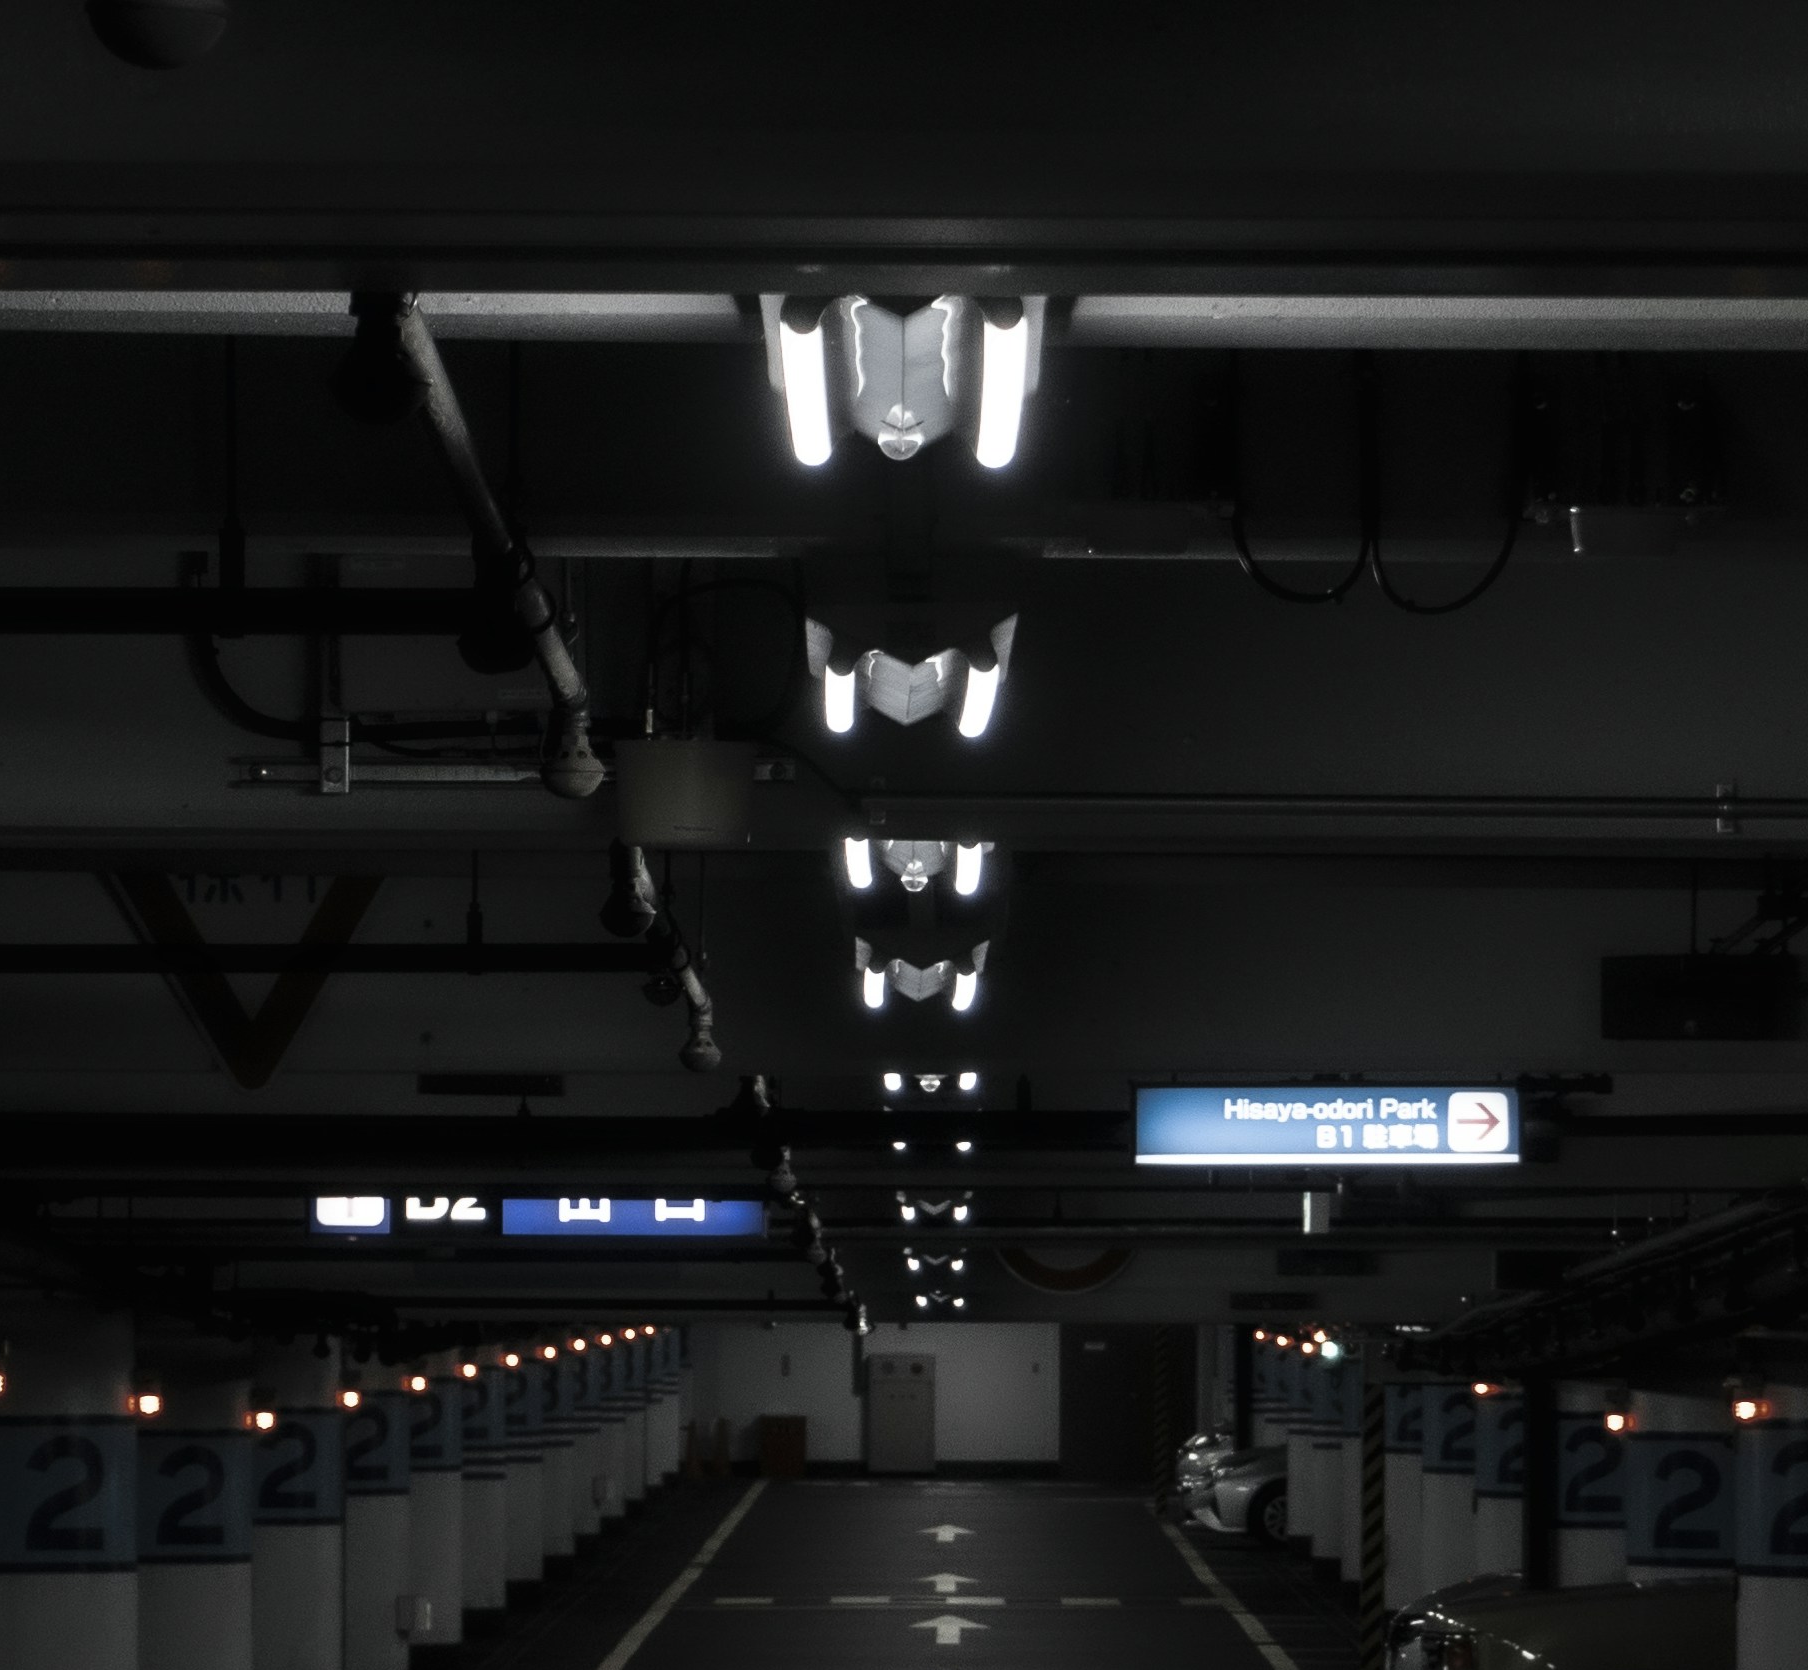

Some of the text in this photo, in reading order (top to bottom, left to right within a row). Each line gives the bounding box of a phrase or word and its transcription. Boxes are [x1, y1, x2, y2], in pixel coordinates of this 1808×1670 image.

[1224, 1098, 1438, 1122] Hisaya-odori Park
[1316, 1124, 1353, 1148] B1
[346, 1405, 388, 1480] 2
[410, 1392, 442, 1458] 2
[1441, 1392, 1475, 1461] 2
[1498, 1407, 1524, 1484] 2
[25, 1435, 105, 1550] 2
[156, 1445, 225, 1545] 2
[258, 1421, 317, 1508] 2
[1565, 1424, 1622, 1512] 2
[1653, 1450, 1720, 1549] 2
